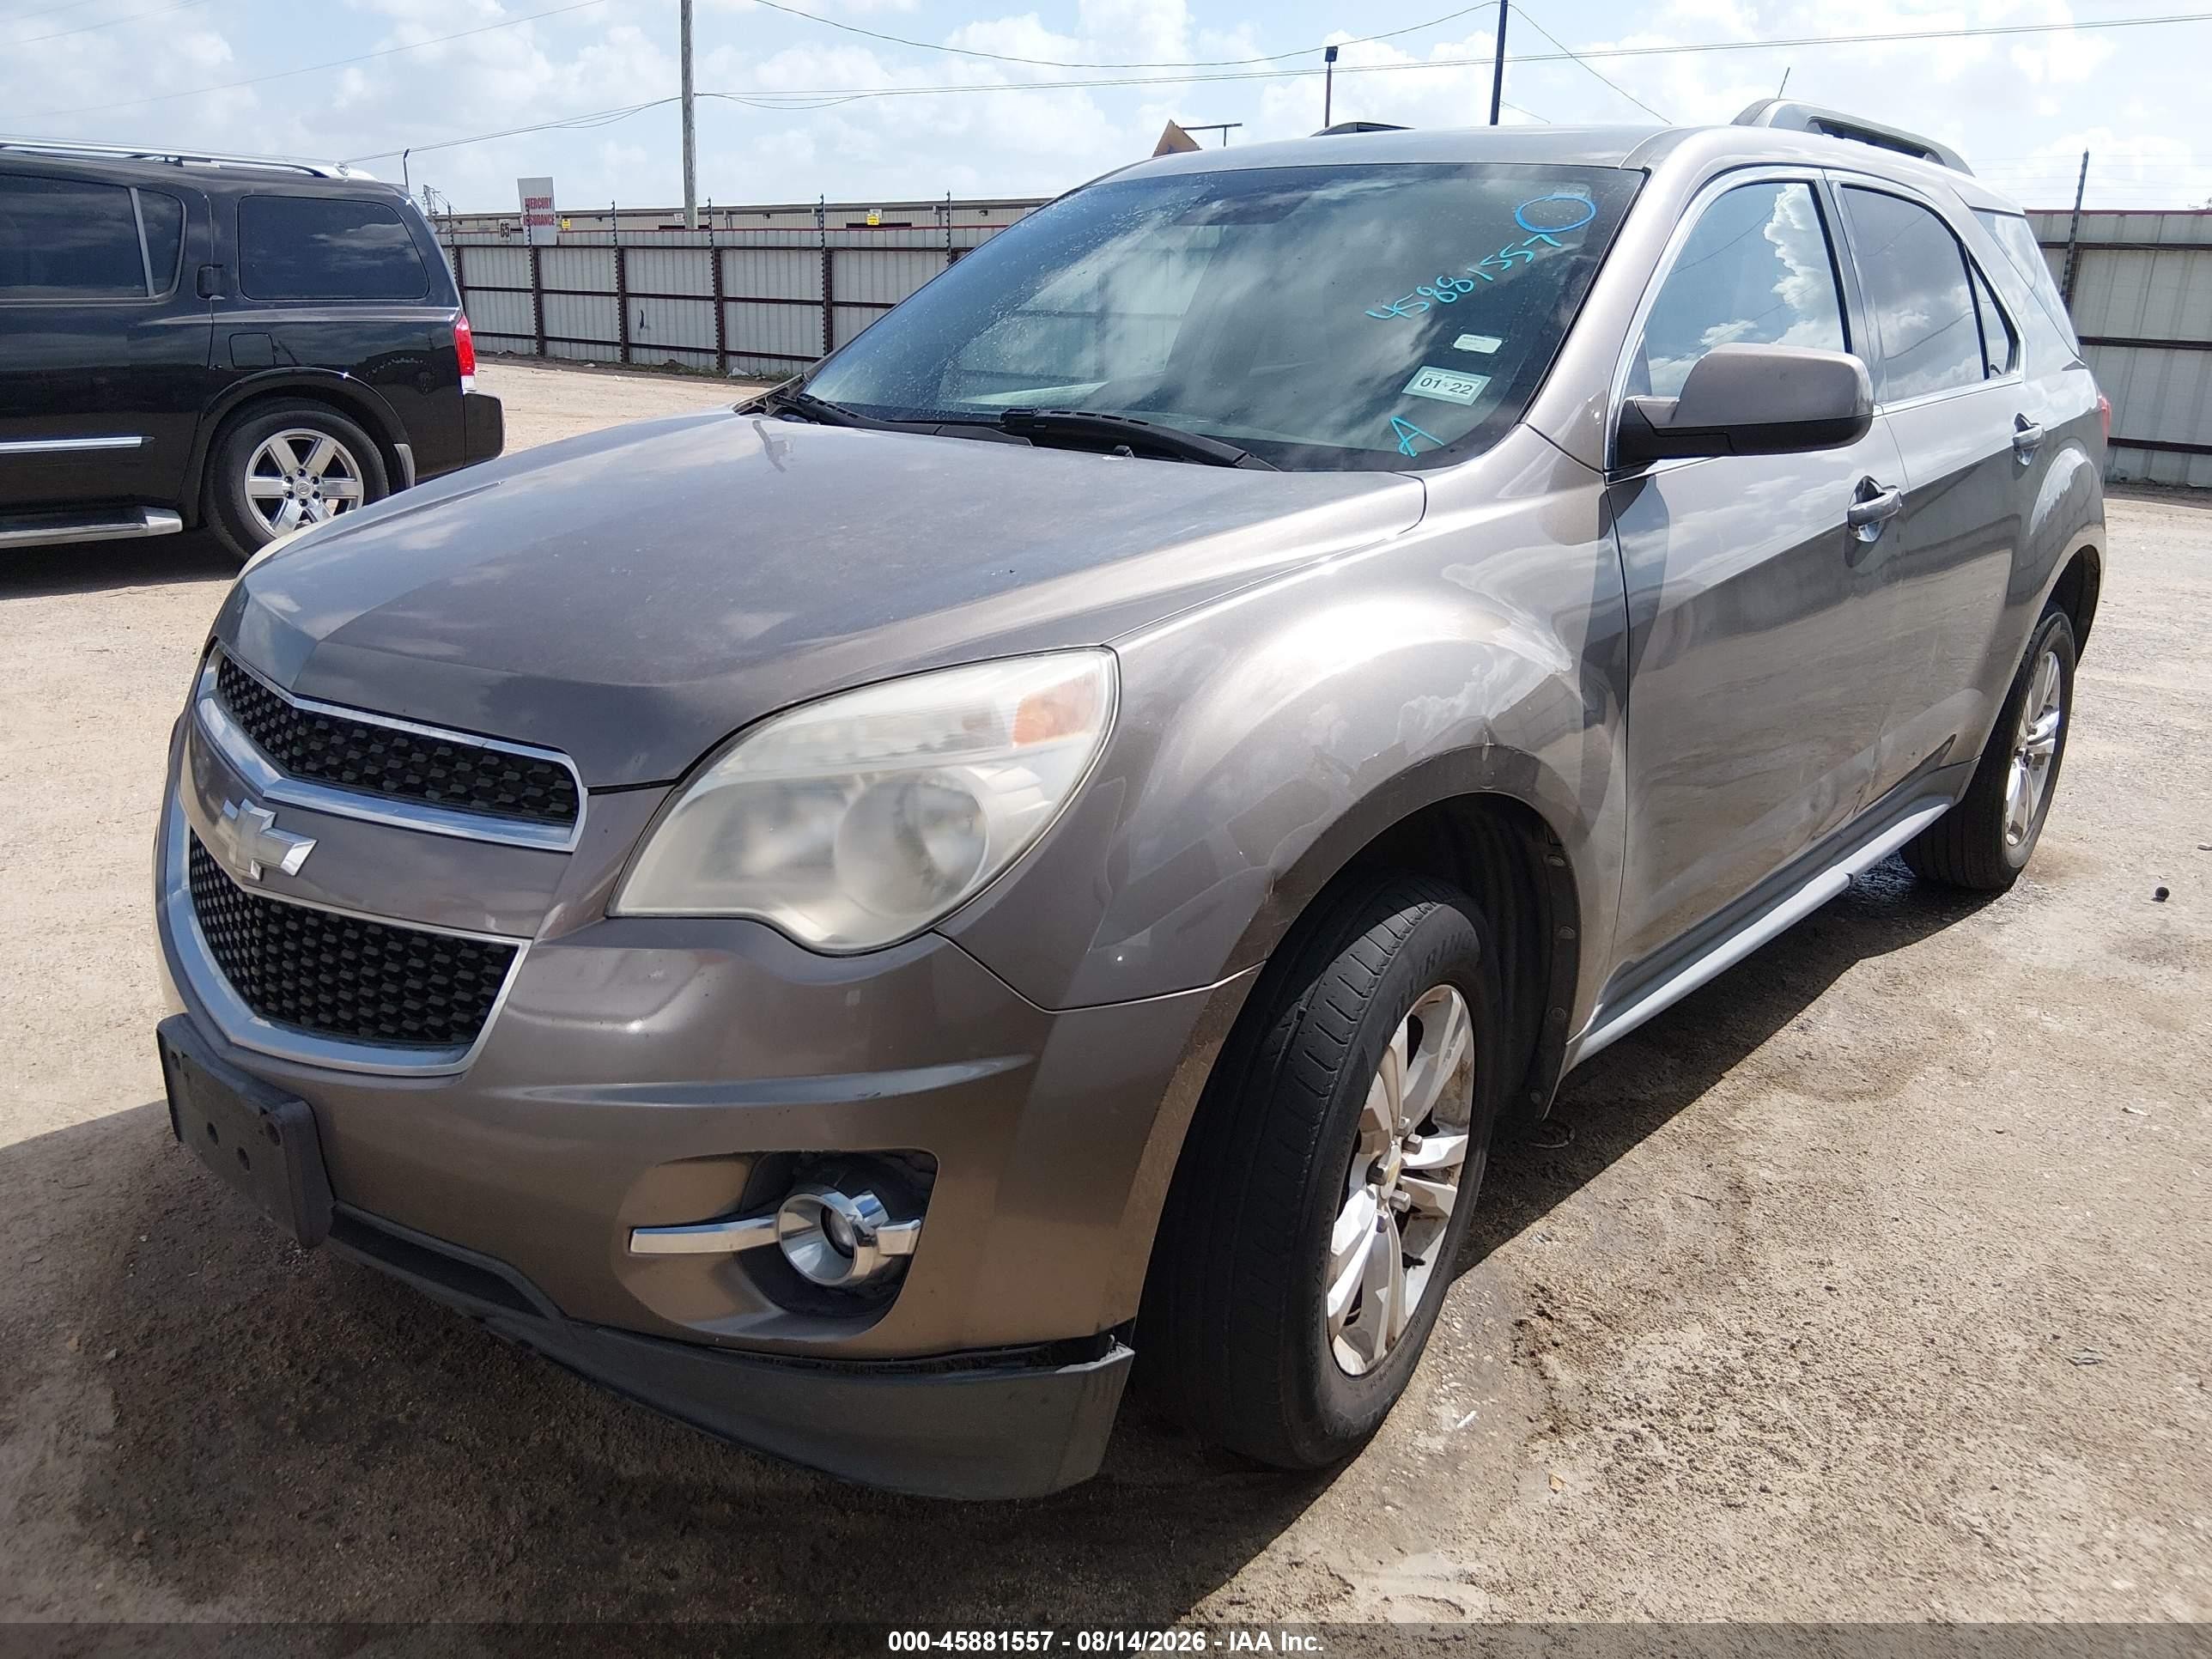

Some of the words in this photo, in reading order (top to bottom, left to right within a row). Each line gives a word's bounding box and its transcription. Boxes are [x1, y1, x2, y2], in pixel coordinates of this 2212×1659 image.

[501, 222, 510, 238] 65
[1419, 377, 1443, 389] 01
[1449, 382, 1474, 395] 22
[1389, 415, 1445, 459] A
